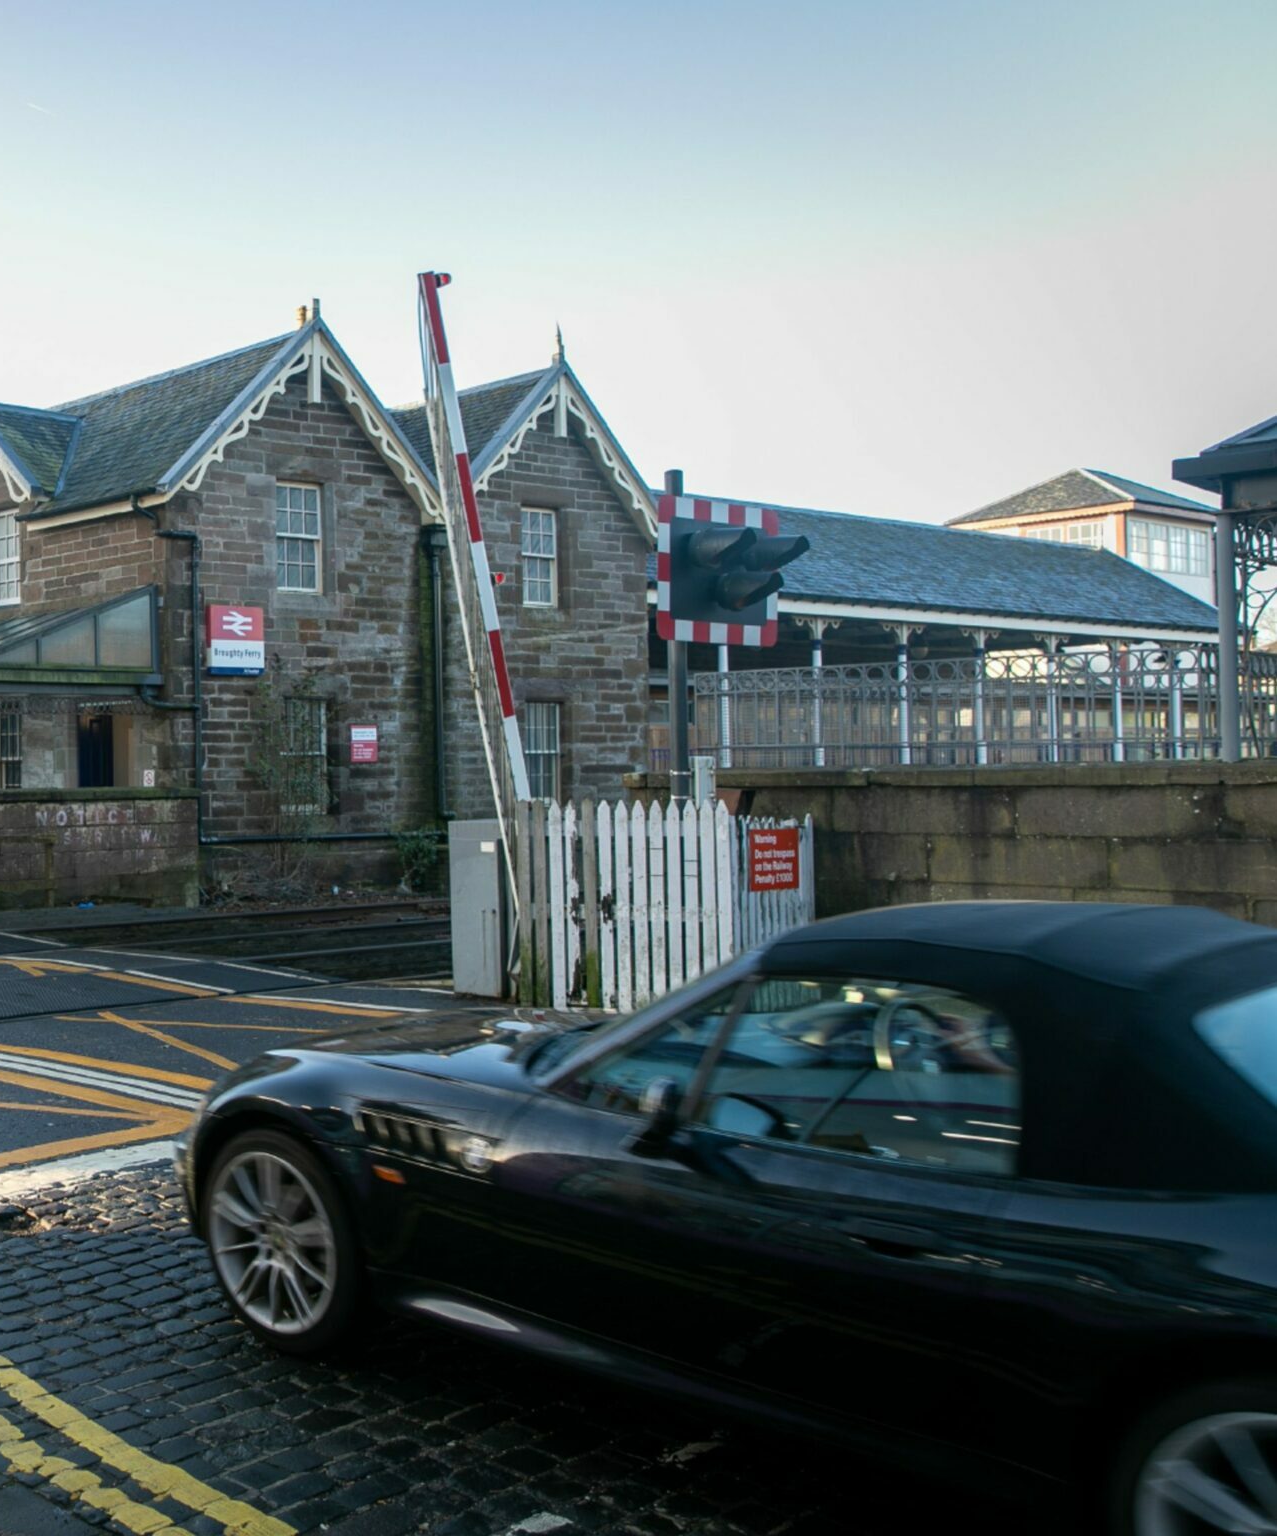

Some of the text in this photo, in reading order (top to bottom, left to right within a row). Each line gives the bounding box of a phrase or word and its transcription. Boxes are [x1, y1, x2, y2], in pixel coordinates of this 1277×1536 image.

[214, 648, 261, 660] Broughty Ferry
[754, 833, 777, 845] Warning
[754, 849, 795, 860] Do not trespass
[754, 860, 793, 872] on the Railway
[754, 873, 775, 885] Penalty
